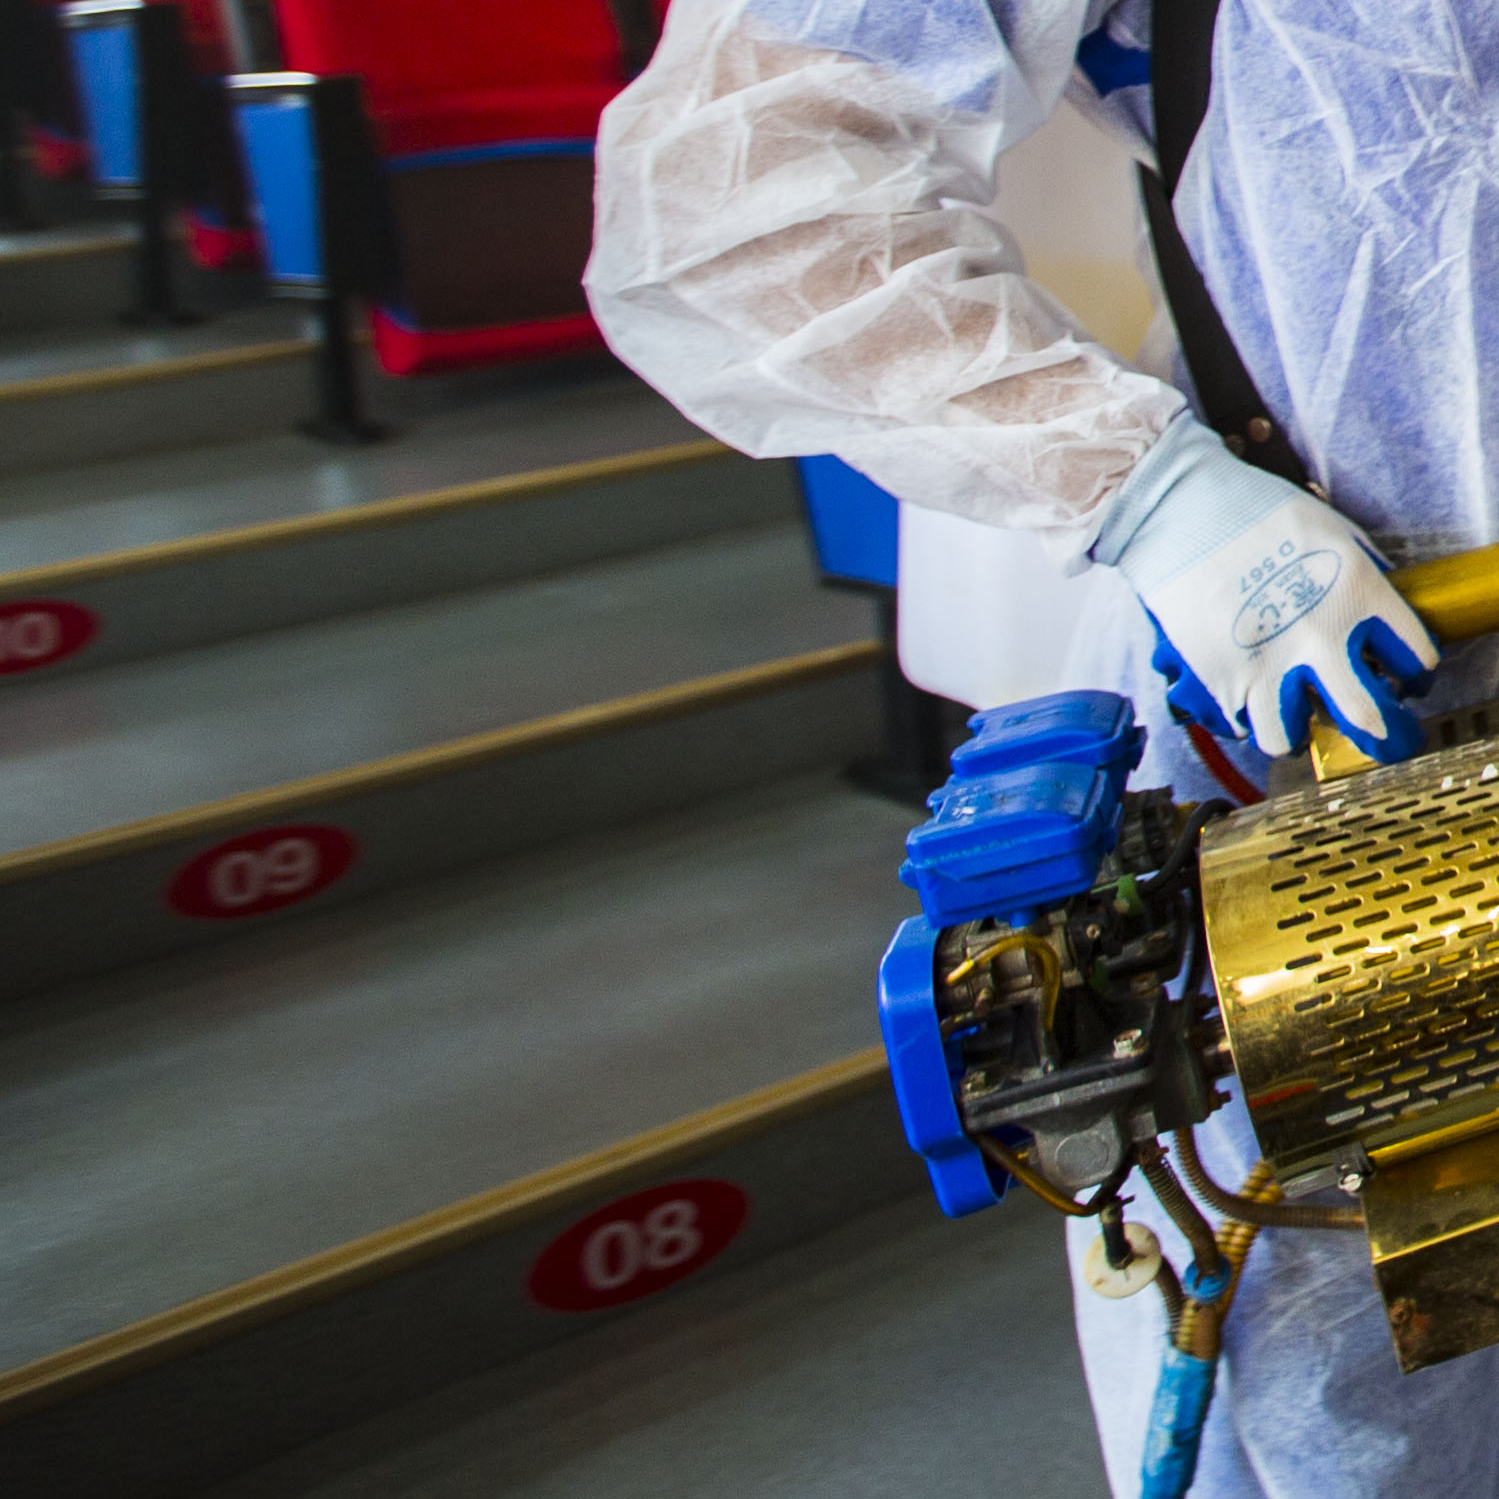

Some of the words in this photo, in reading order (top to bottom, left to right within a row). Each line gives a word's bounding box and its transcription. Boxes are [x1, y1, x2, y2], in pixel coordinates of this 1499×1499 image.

[1239, 557, 1276, 594] 567
[211, 838, 317, 907] 09
[582, 1199, 703, 1290] 08
